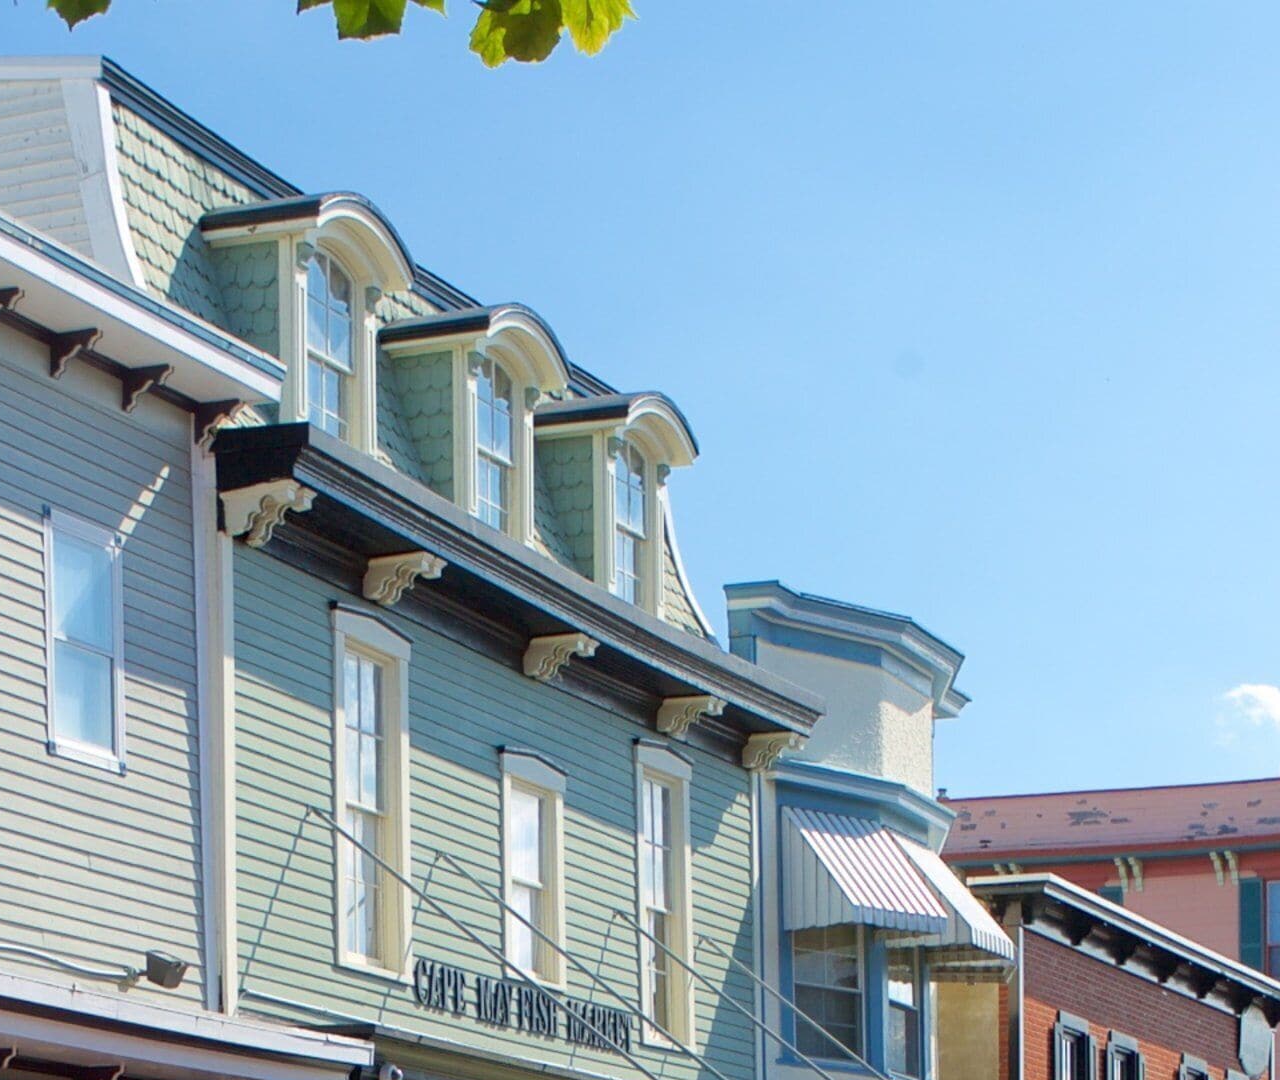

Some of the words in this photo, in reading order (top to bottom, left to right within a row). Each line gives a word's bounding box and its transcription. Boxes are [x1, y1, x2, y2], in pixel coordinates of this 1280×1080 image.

[413, 958, 467, 1013] CAPE
[476, 976, 513, 1025] MAY
[518, 987, 561, 1037] FISH
[566, 999, 634, 1053] MARKET
